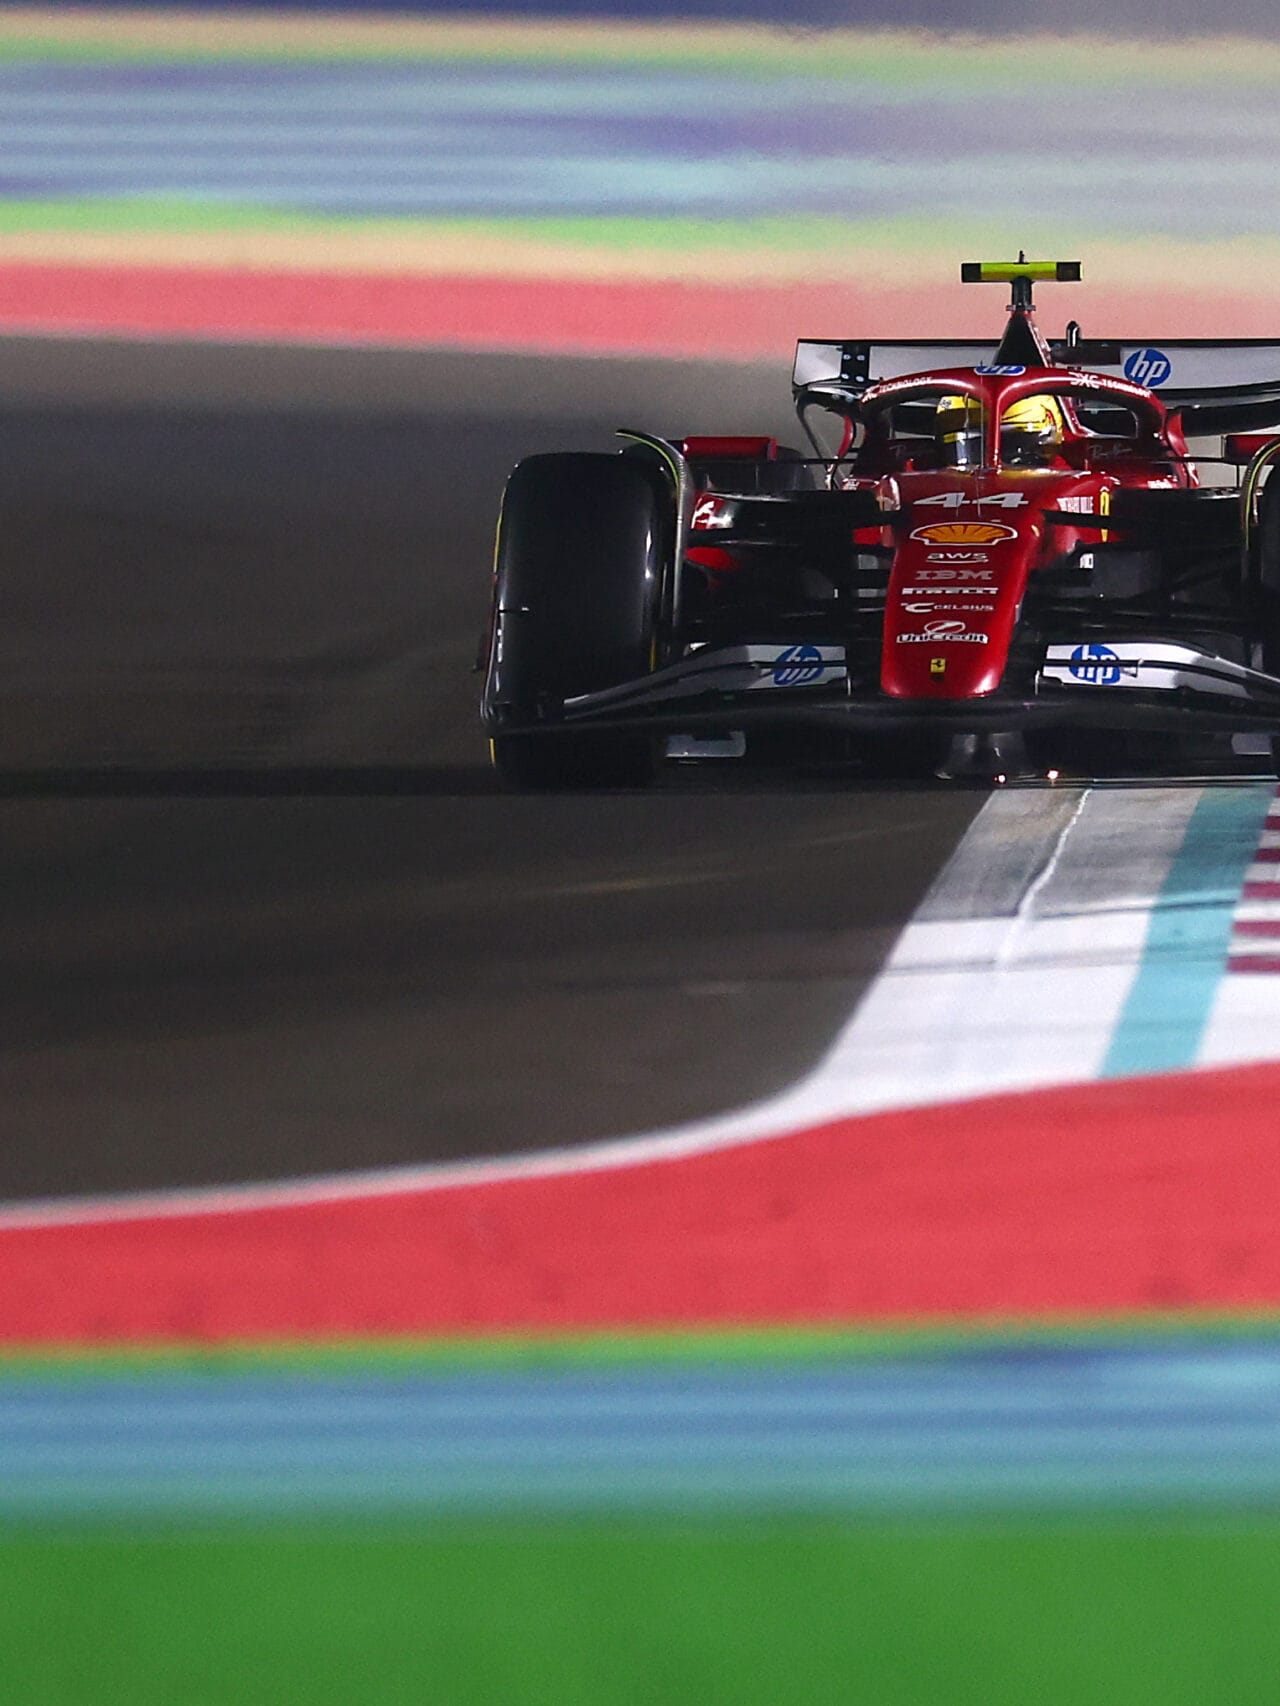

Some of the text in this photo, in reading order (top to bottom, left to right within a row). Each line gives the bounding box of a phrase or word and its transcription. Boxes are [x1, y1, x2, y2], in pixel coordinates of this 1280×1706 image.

[1127, 348, 1168, 387] hp
[913, 491, 1029, 508] 44
[927, 552, 988, 561] aws
[915, 570, 993, 580] IBM
[902, 587, 999, 595] PIRELLI
[897, 632, 988, 644] UniCredit
[778, 645, 819, 686] hp
[1077, 645, 1117, 685] hp
